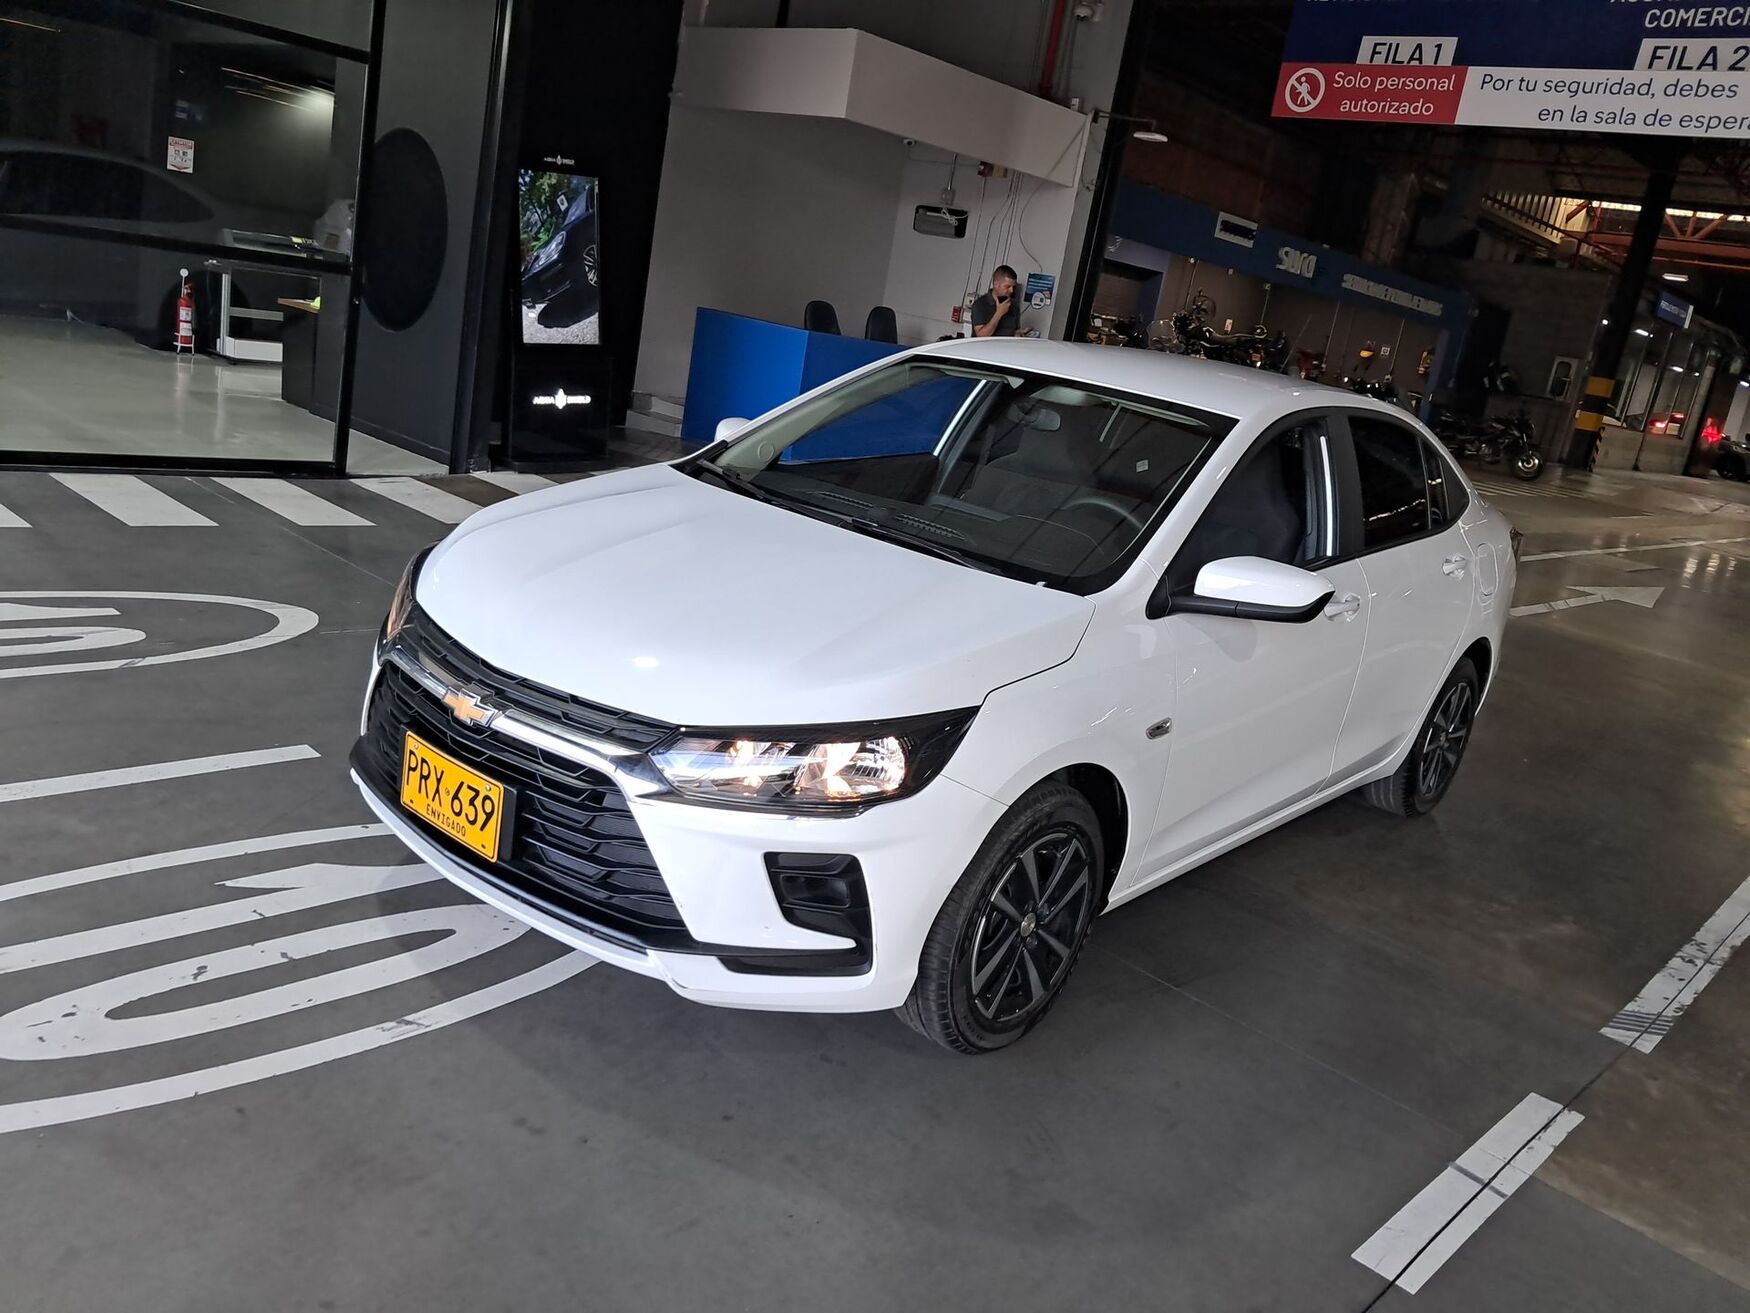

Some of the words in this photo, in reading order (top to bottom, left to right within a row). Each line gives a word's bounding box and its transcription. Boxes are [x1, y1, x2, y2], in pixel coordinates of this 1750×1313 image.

[1645, 6, 1750, 28] COMERCI
[1369, 42, 1423, 65] FILA
[1433, 43, 1443, 65] 1
[1648, 45, 1718, 71] FILA
[1727, 45, 1750, 72] 2
[1333, 71, 1371, 89] Solo
[1374, 73, 1456, 93] personal
[1480, 73, 1514, 92] Por
[1518, 76, 1538, 92] tu
[1543, 76, 1655, 99] seguridad,
[1663, 77, 1739, 99] debes
[1340, 97, 1434, 116] autorizado
[1538, 107, 1564, 122] en
[1570, 104, 1588, 123] la
[1593, 106, 1636, 126] sala
[1643, 108, 1672, 128] de
[406, 750, 444, 807] PRX
[450, 780, 496, 832] 639
[426, 803, 466, 836] ENVIGADO
